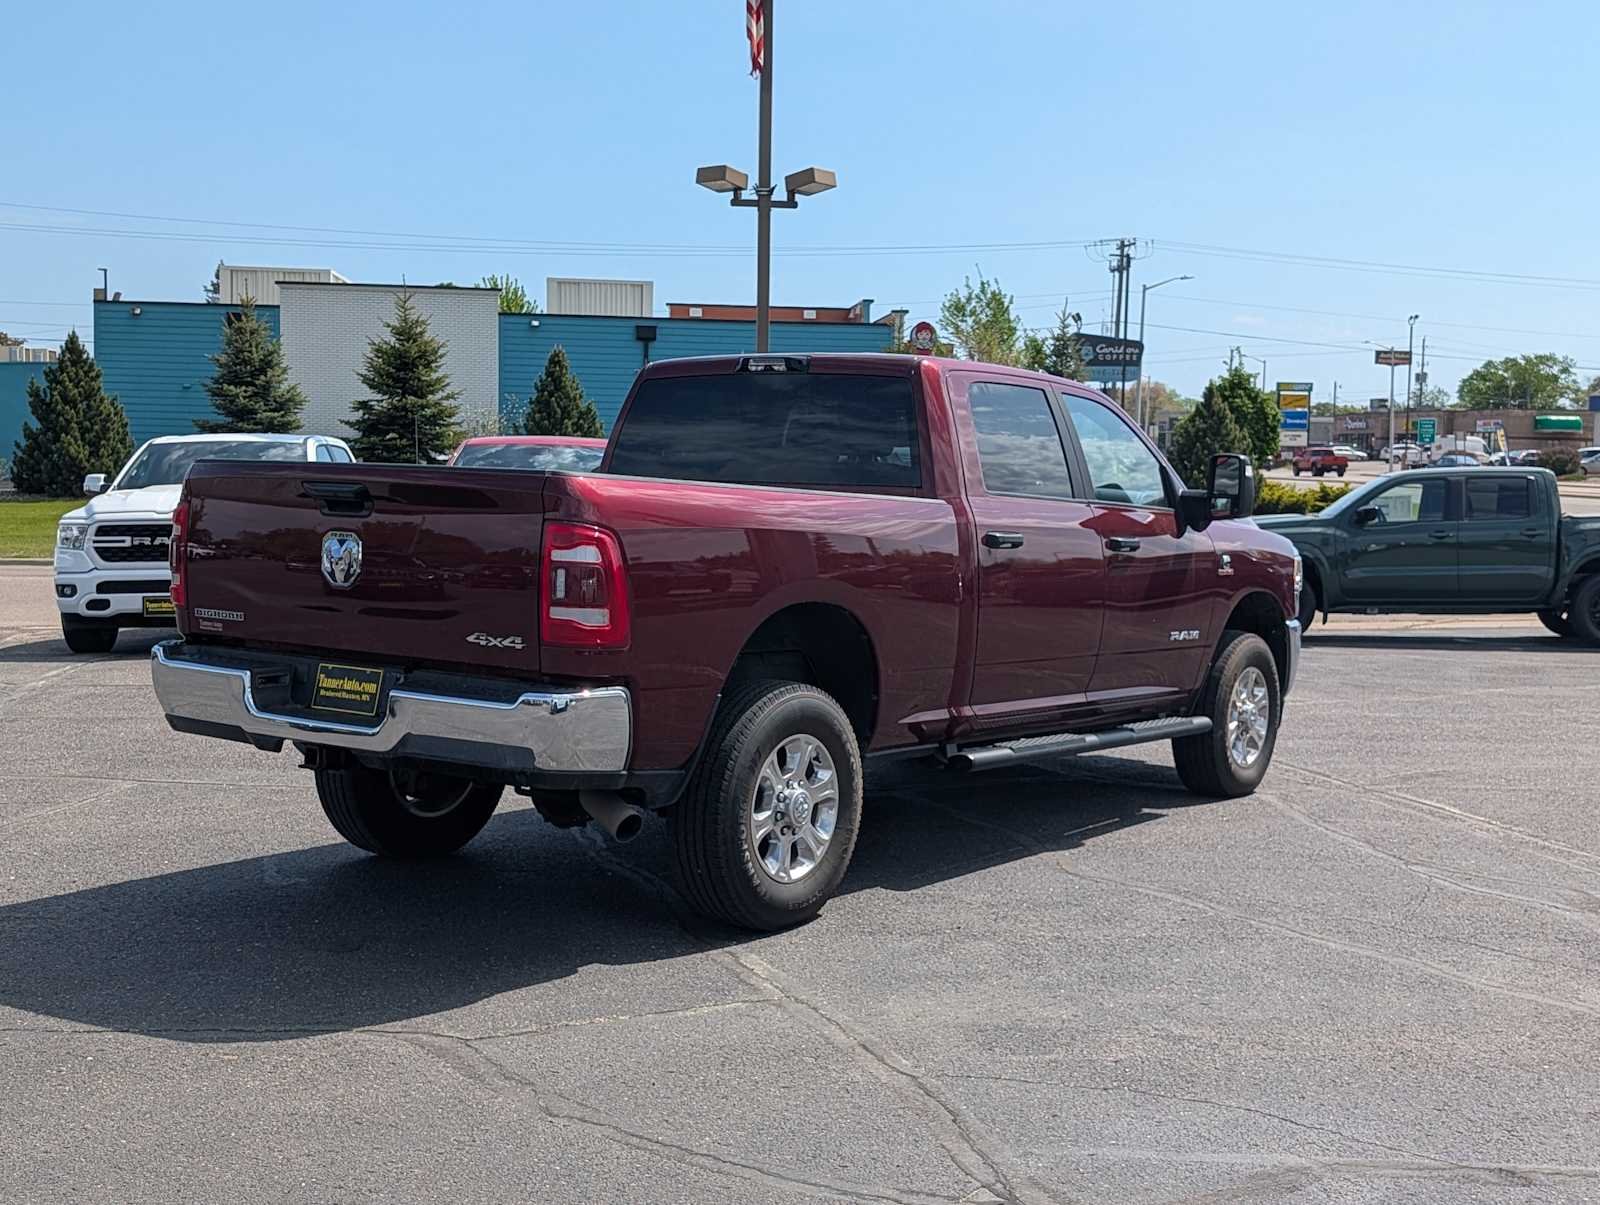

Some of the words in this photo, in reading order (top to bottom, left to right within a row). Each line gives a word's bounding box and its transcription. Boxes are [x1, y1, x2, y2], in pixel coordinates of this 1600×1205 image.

[133, 537, 170, 546] RA
[466, 632, 527, 650] 4x4
[1170, 630, 1200, 641] RAM
[319, 673, 378, 694] TannerAuto.com
